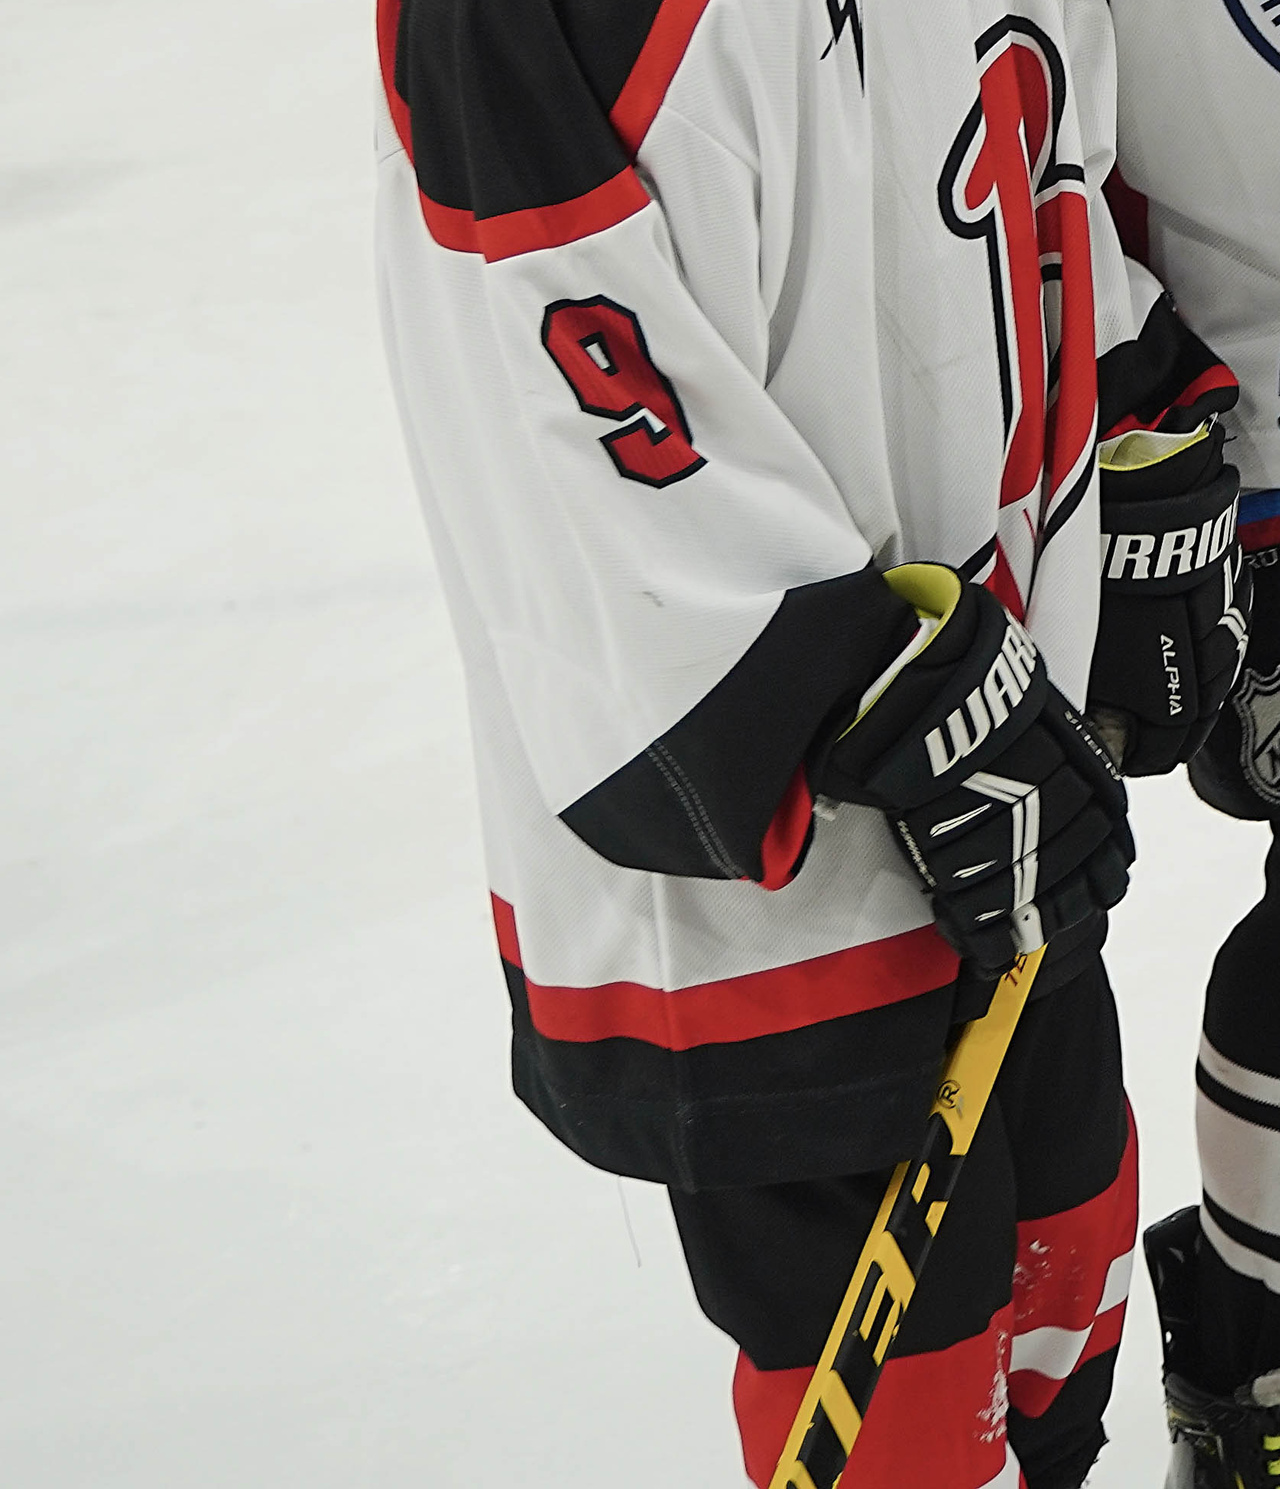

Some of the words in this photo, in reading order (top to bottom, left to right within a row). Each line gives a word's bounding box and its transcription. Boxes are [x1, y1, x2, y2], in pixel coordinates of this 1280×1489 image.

[540, 293, 708, 489] 9
[924, 607, 1038, 778] WAR
[1160, 633, 1183, 716] ALPHA
